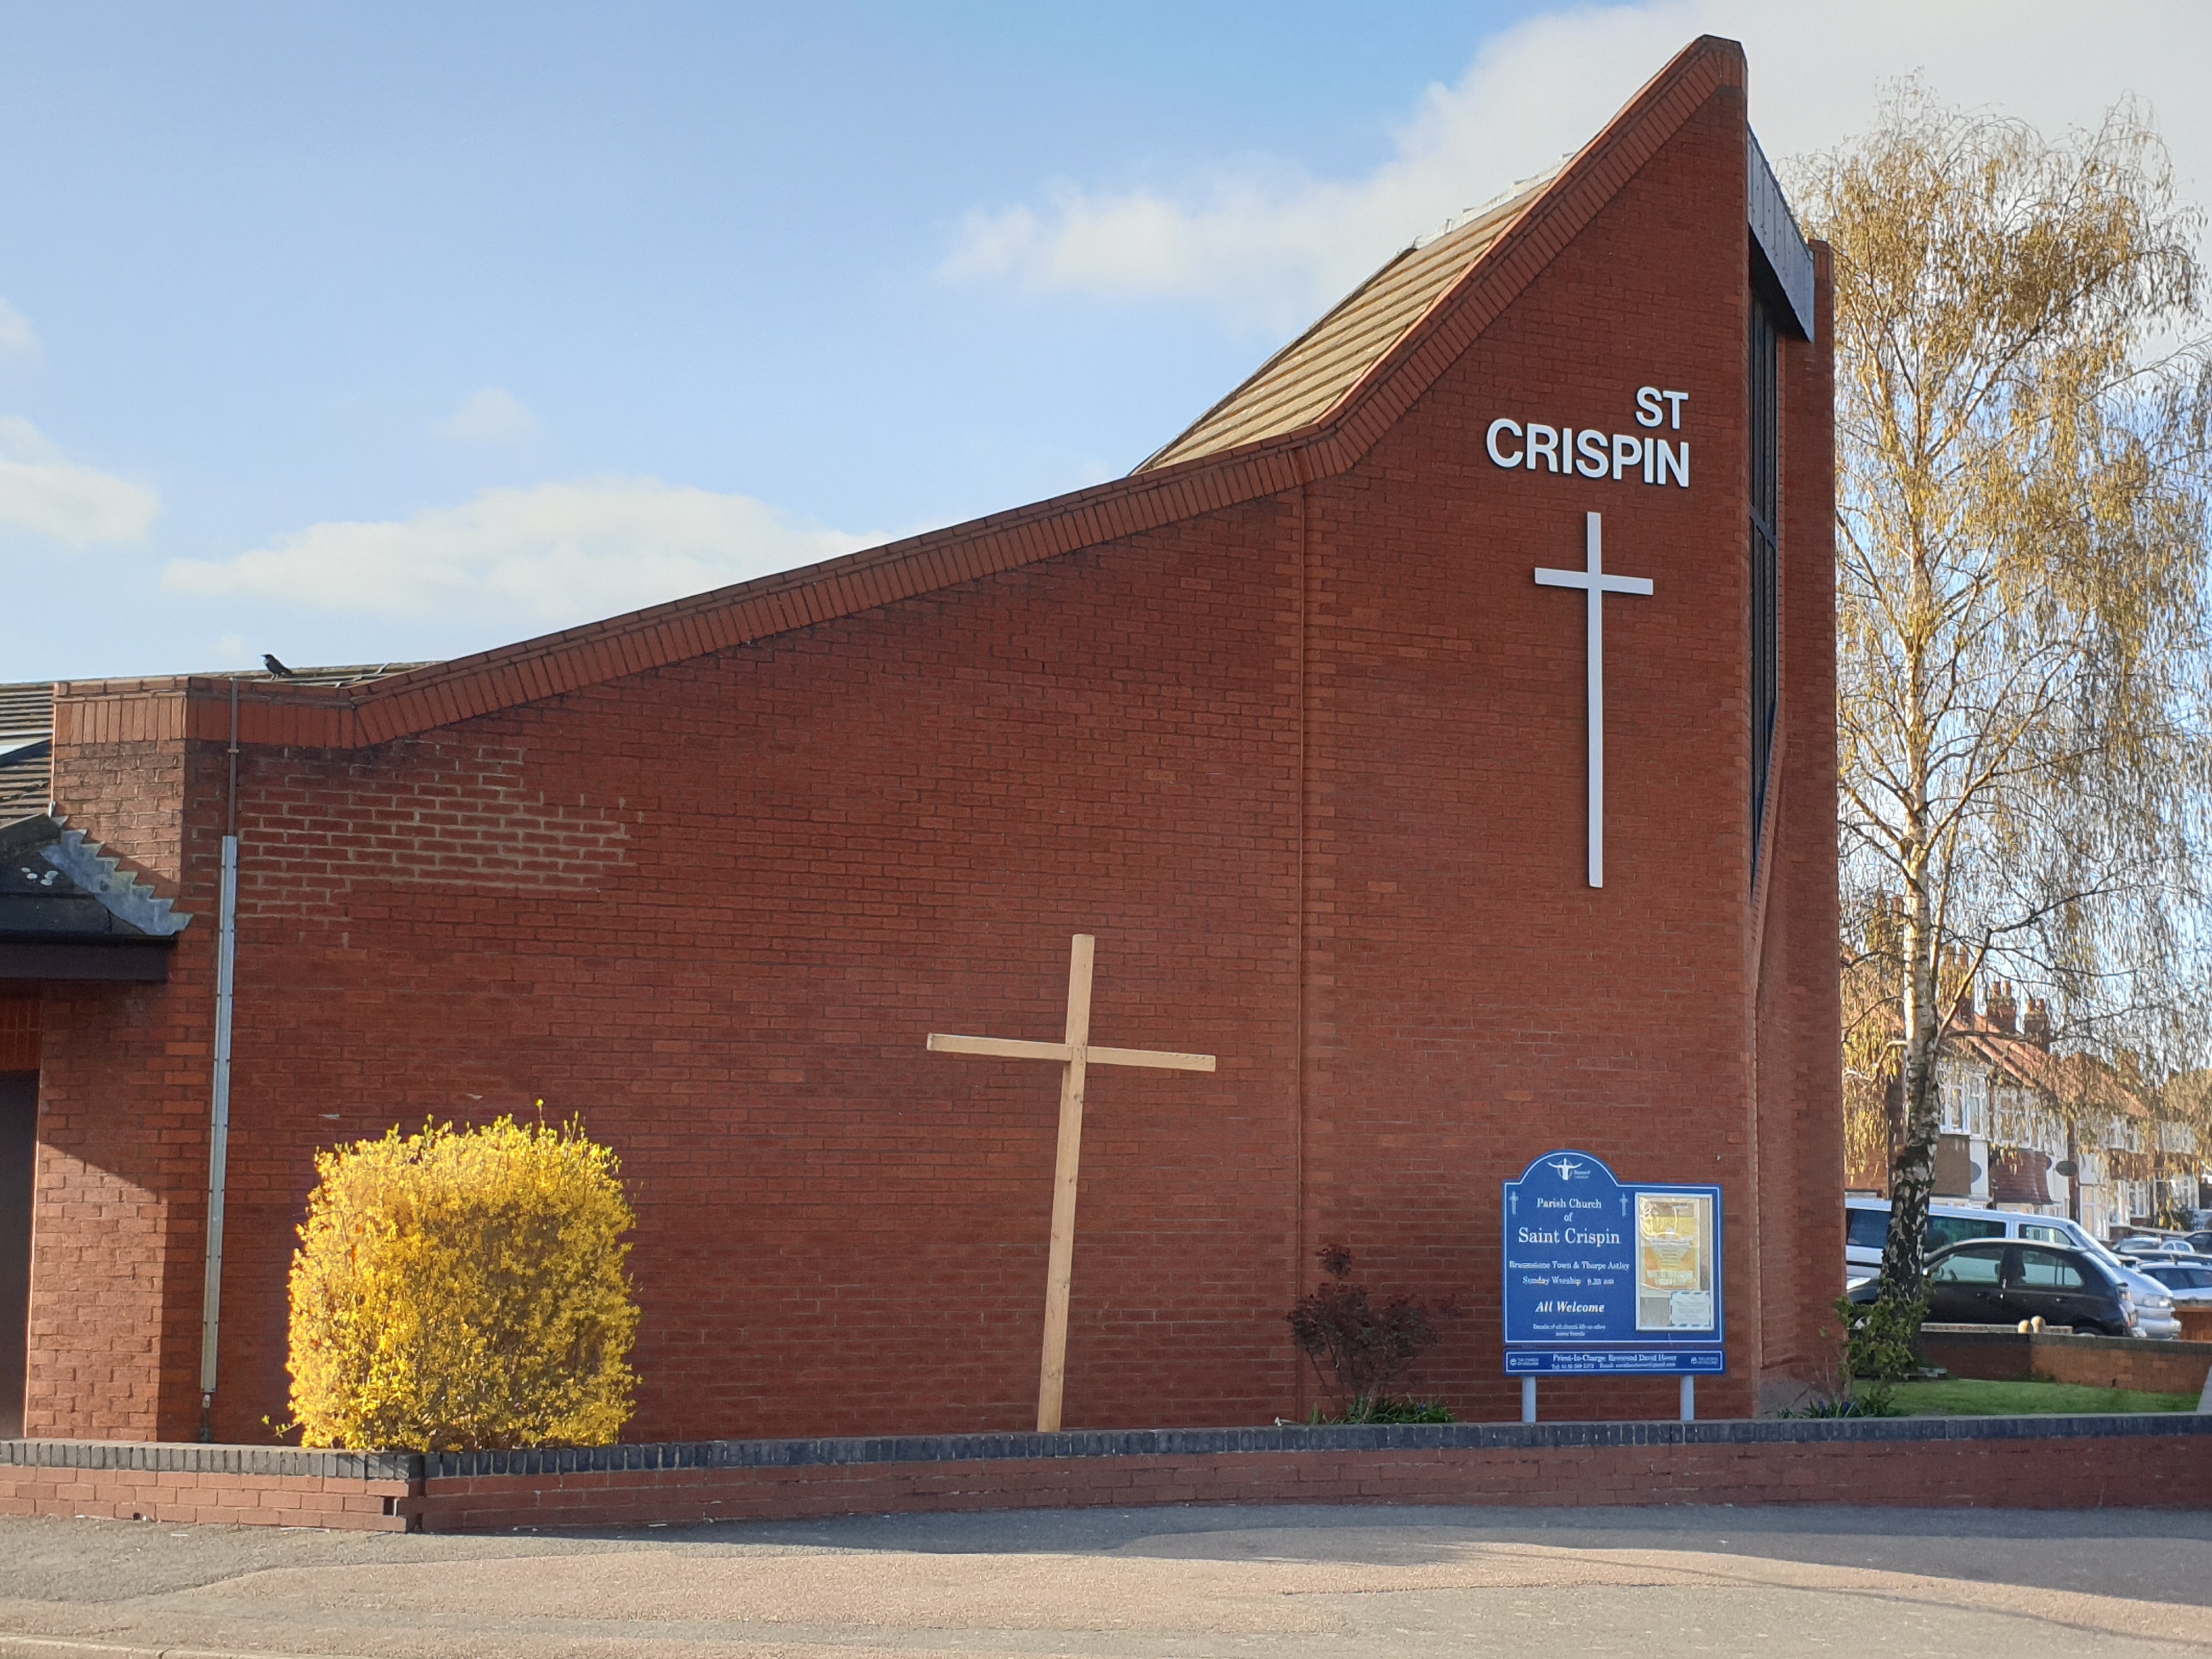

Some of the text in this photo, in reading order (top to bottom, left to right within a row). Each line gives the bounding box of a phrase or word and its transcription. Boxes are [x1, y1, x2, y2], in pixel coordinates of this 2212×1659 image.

[1635, 386, 1689, 430] ST
[1486, 418, 1690, 488] CRISPIN
[1537, 1198, 1602, 1209] Parish Church
[1564, 1211, 1573, 1222] of
[1518, 1227, 1621, 1247] Saint Crispin
[1552, 1261, 1572, 1269] Town
[1582, 1261, 1606, 1271] Thorpe
[1522, 1276, 1550, 1285] Sunday
[1551, 1276, 1581, 1286] Worship
[1535, 1301, 1605, 1313] All Welcome
